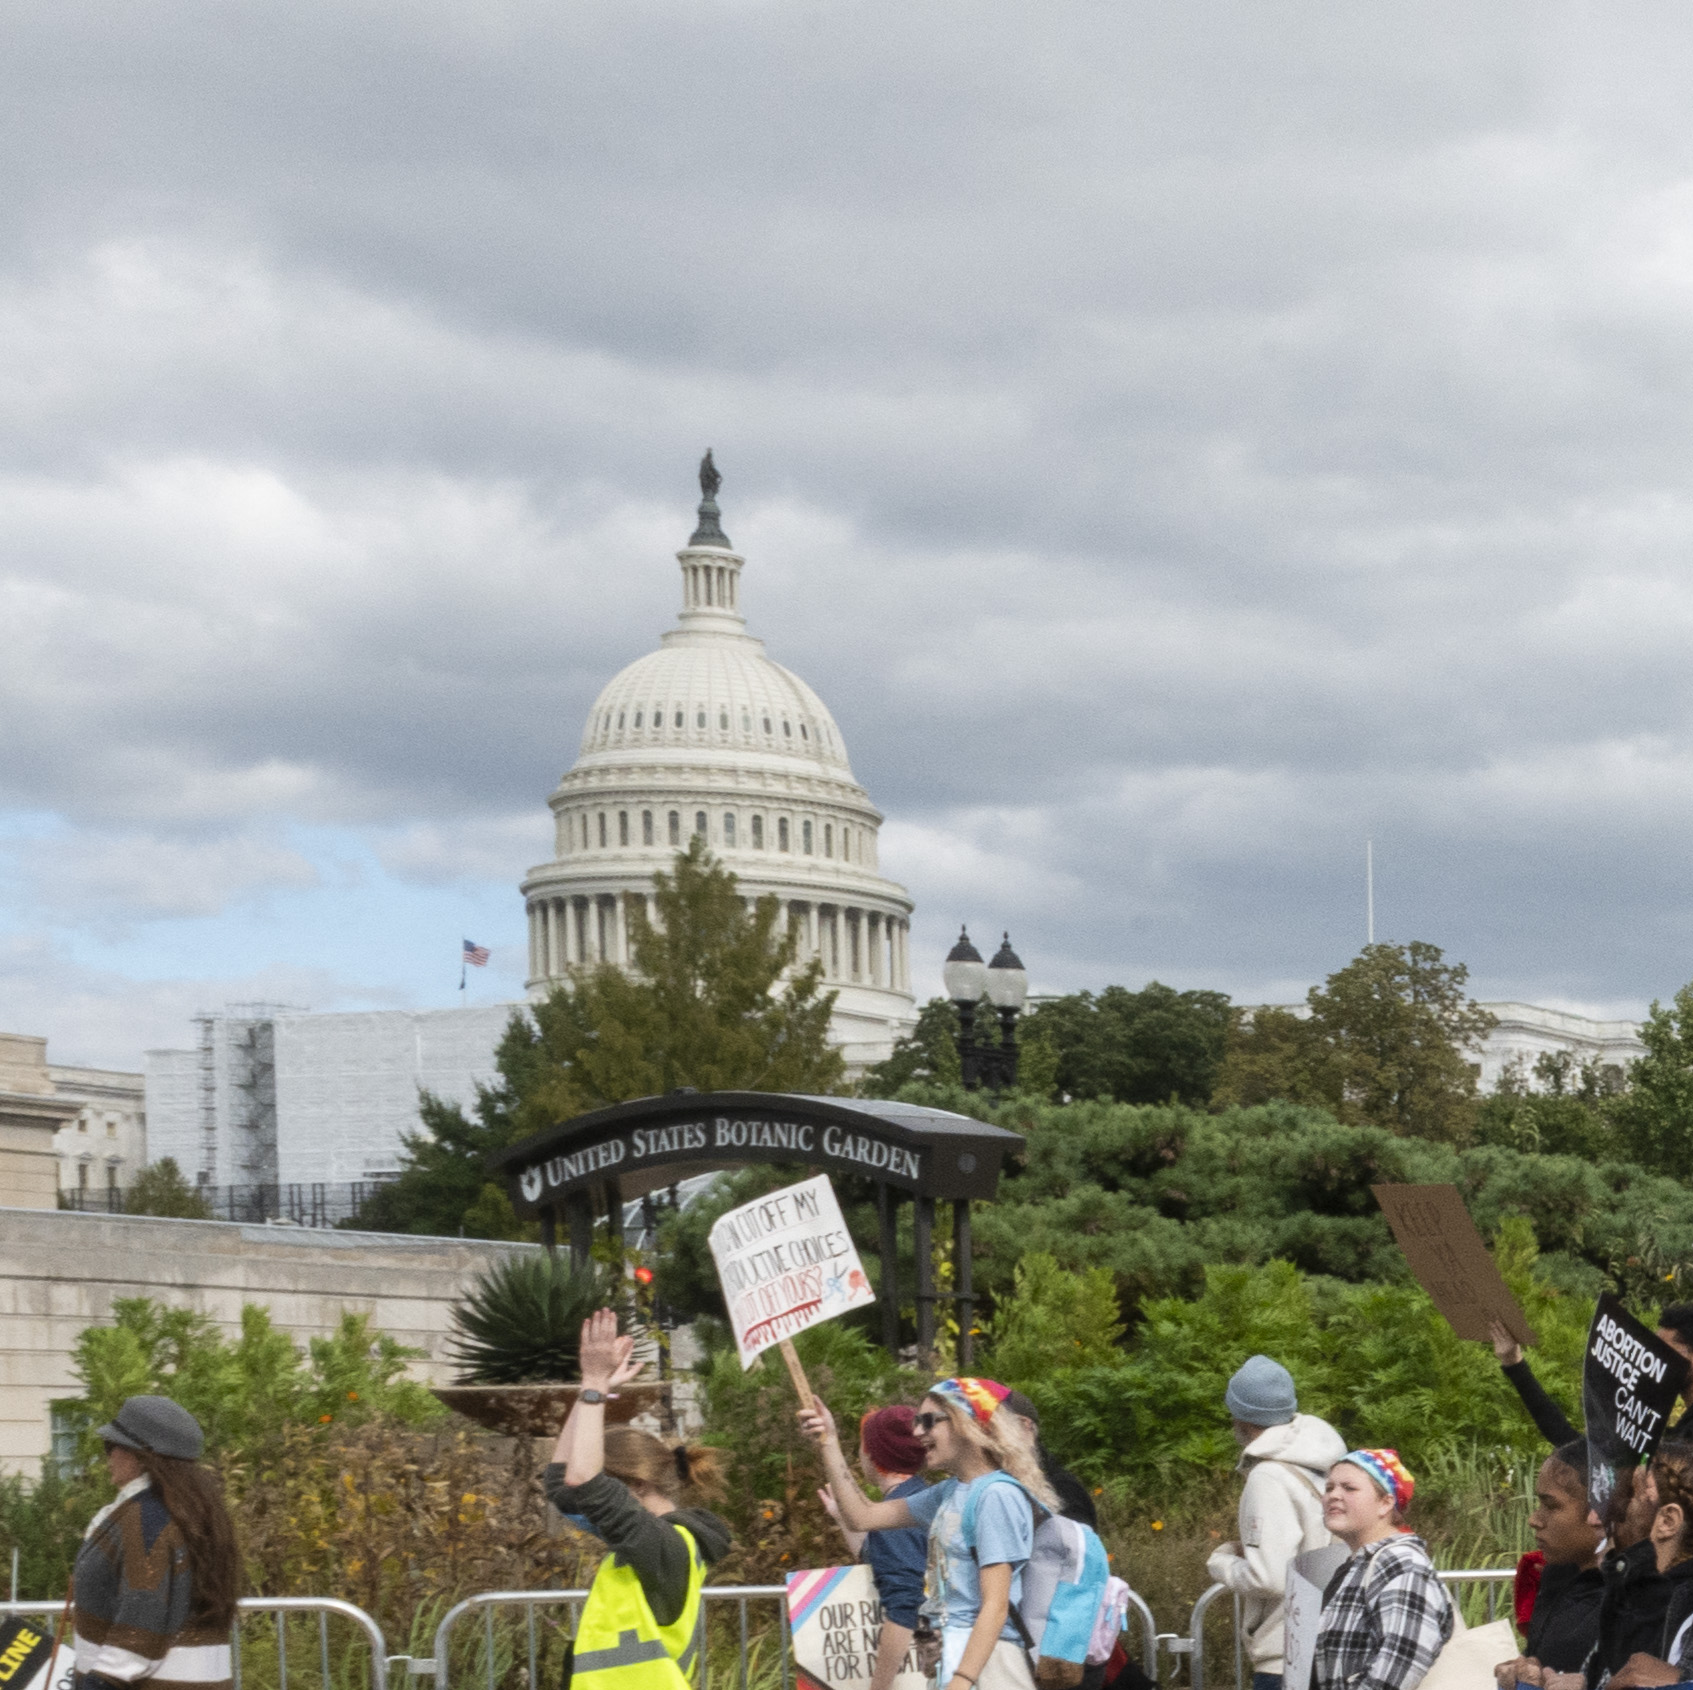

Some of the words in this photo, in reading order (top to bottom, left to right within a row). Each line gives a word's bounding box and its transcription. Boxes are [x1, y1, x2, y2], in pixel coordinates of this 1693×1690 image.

[546, 1138, 626, 1187] UNITED
[632, 1122, 706, 1158] STATES
[714, 1117, 814, 1152] BOTANIC
[822, 1125, 921, 1180] GARDEN
[793, 1188, 820, 1221] MY
[1591, 1336, 1641, 1392] JUSTICE
[1597, 1314, 1668, 1383] ABORTION
[1615, 1387, 1662, 1432] CAN'T
[819, 1601, 855, 1632] OUR
[822, 1628, 857, 1655] ARE
[825, 1654, 864, 1682] FOR
